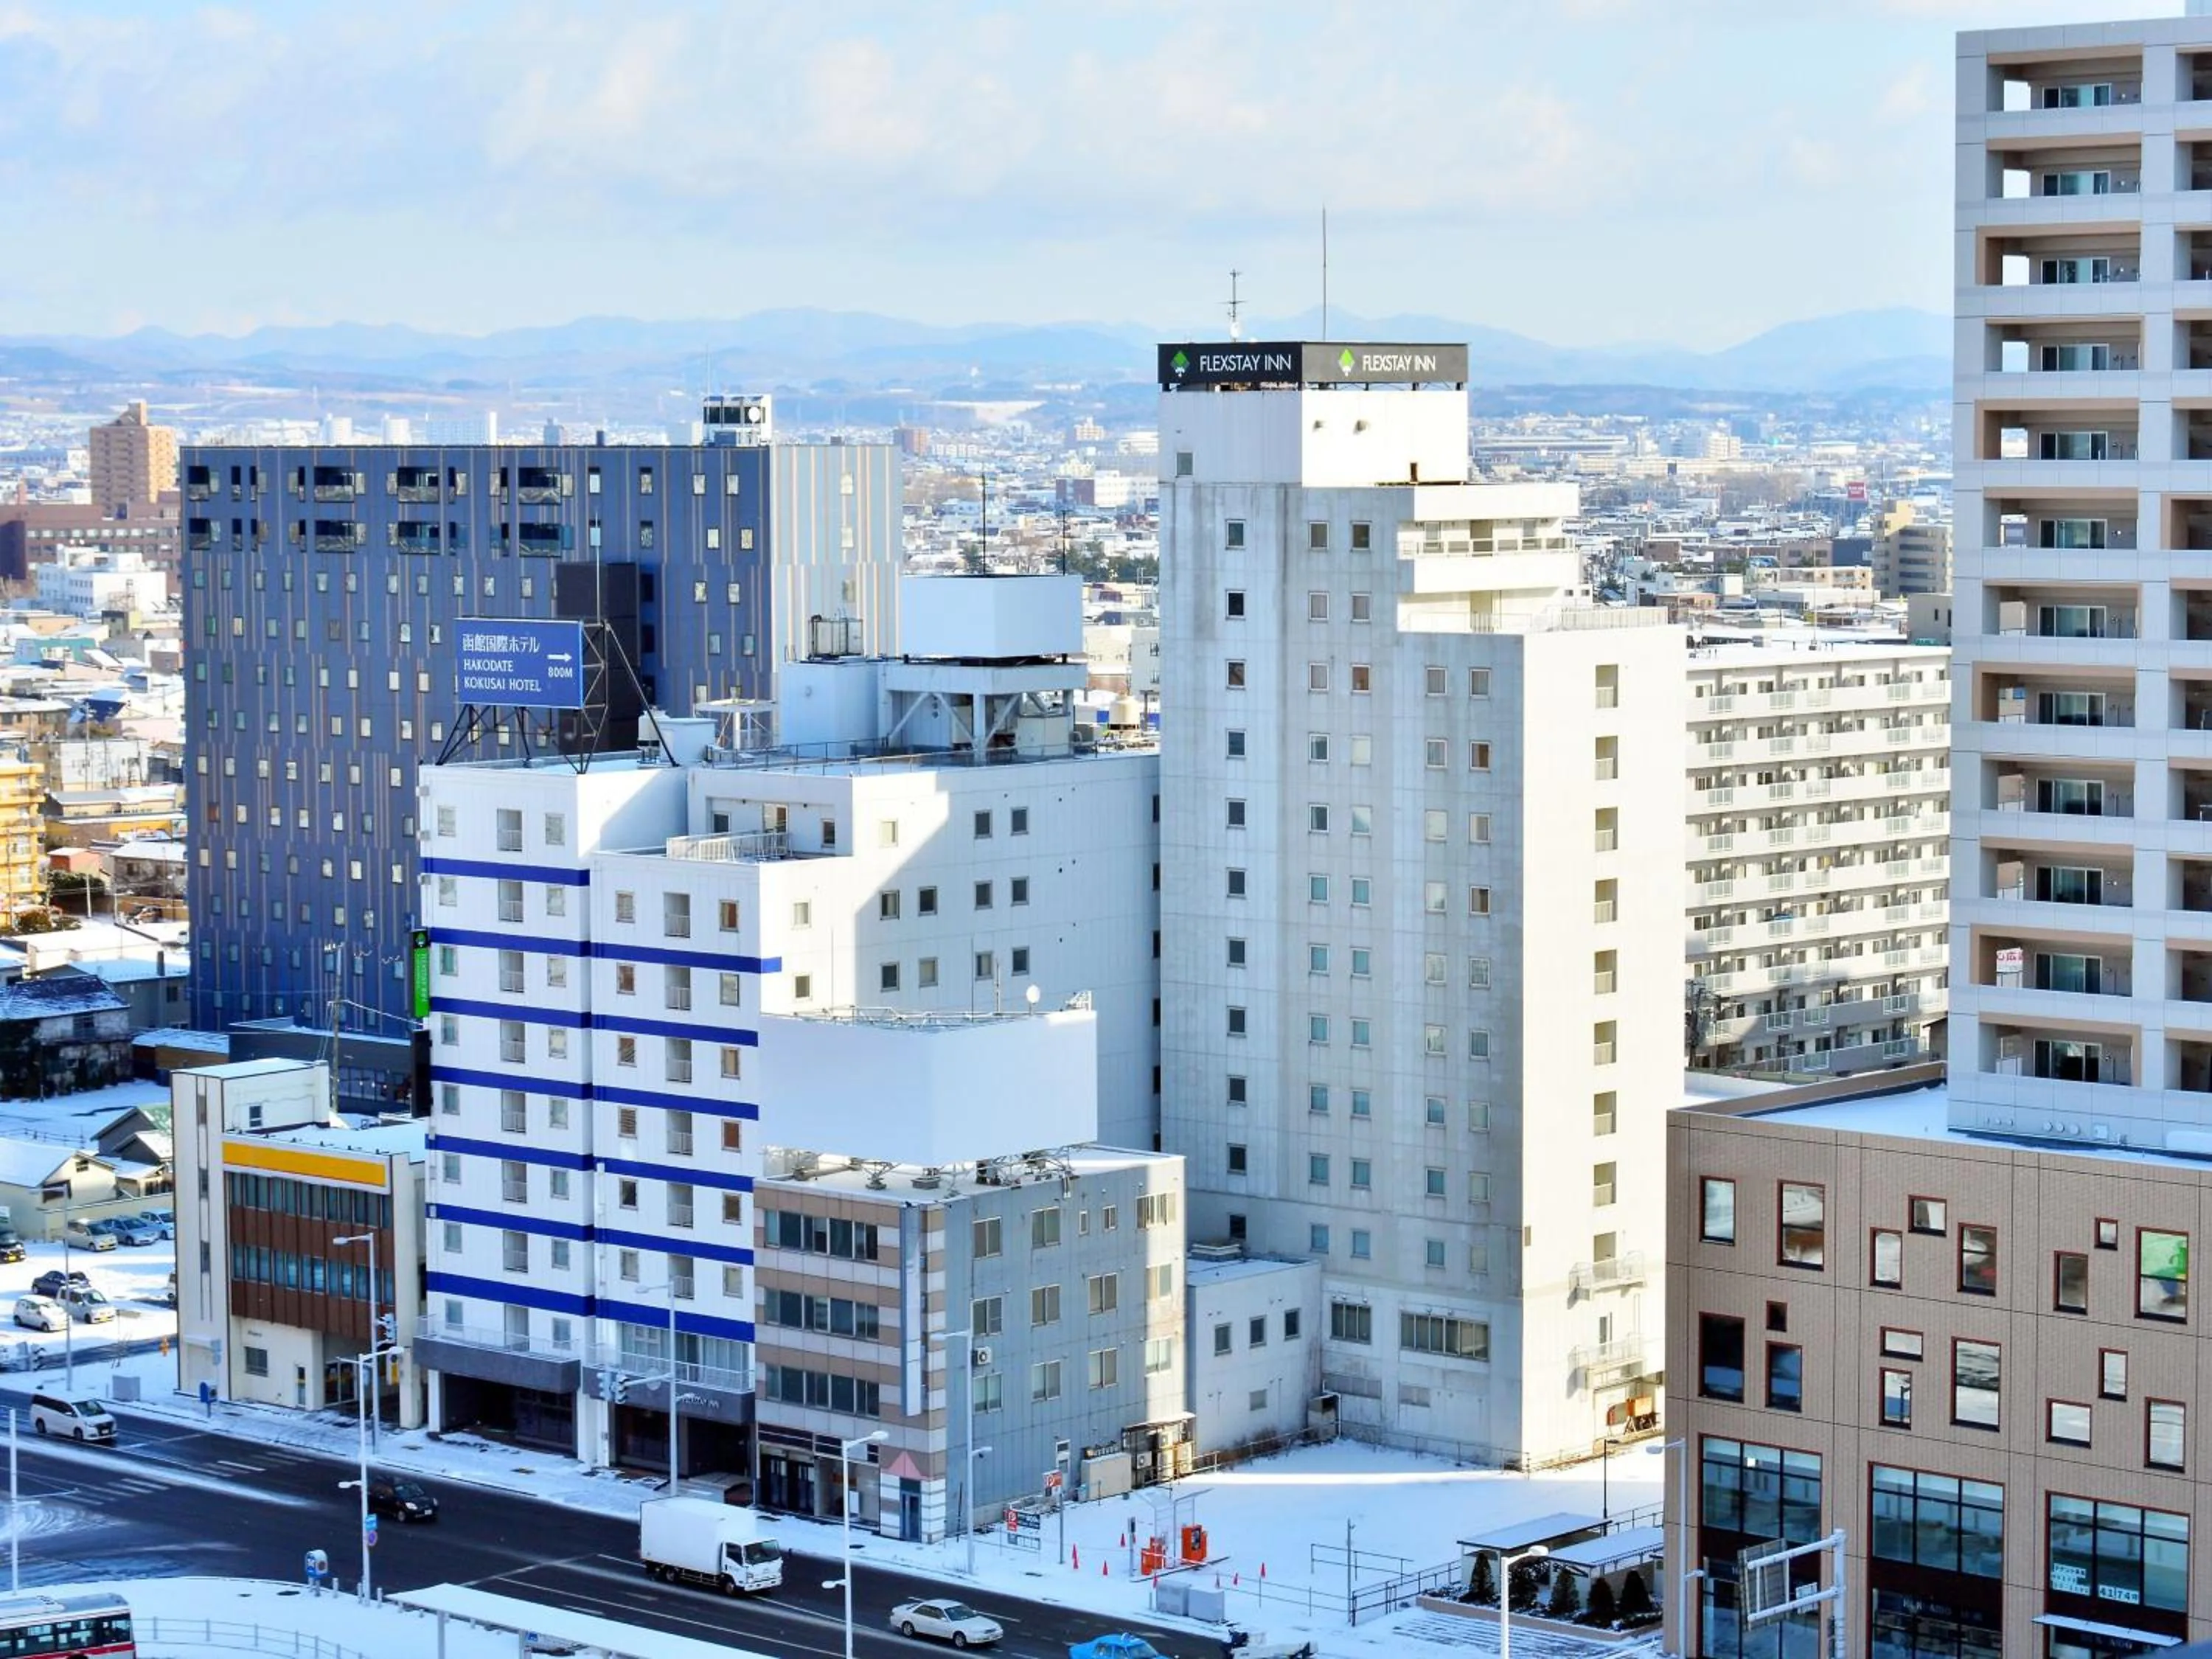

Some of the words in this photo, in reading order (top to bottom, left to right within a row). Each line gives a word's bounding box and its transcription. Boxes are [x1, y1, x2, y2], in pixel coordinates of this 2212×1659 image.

[1199, 354, 1261, 372] FLEXSTAY
[1264, 353, 1292, 371] INN
[1361, 354, 1412, 372] FLEXSTAY
[1413, 354, 1436, 372] INN
[462, 633, 540, 653] 函館国際ホテル
[463, 658, 515, 672] HAKODATE
[547, 666, 574, 679] 800M
[464, 676, 505, 690] KOKUSAI
[509, 678, 542, 692] HOTEL
